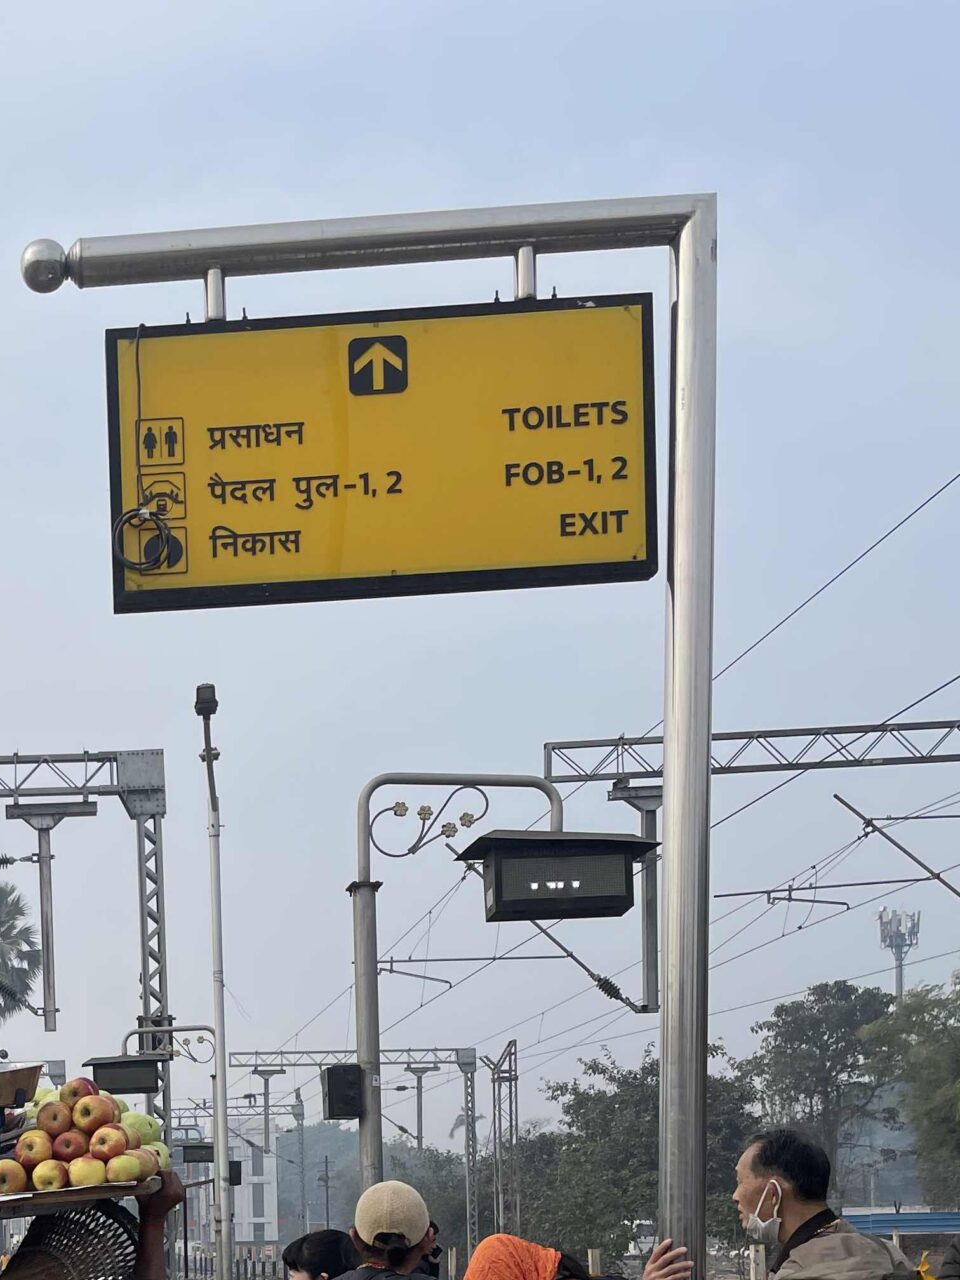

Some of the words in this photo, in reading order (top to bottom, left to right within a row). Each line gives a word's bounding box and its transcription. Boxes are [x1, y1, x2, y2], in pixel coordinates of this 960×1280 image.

[501, 400, 629, 432] TOILETS
[206, 421, 305, 450] प्रसाधन
[207, 471, 277, 505] पैदल
[559, 509, 629, 538] EXIT
[208, 525, 302, 558] निकास
